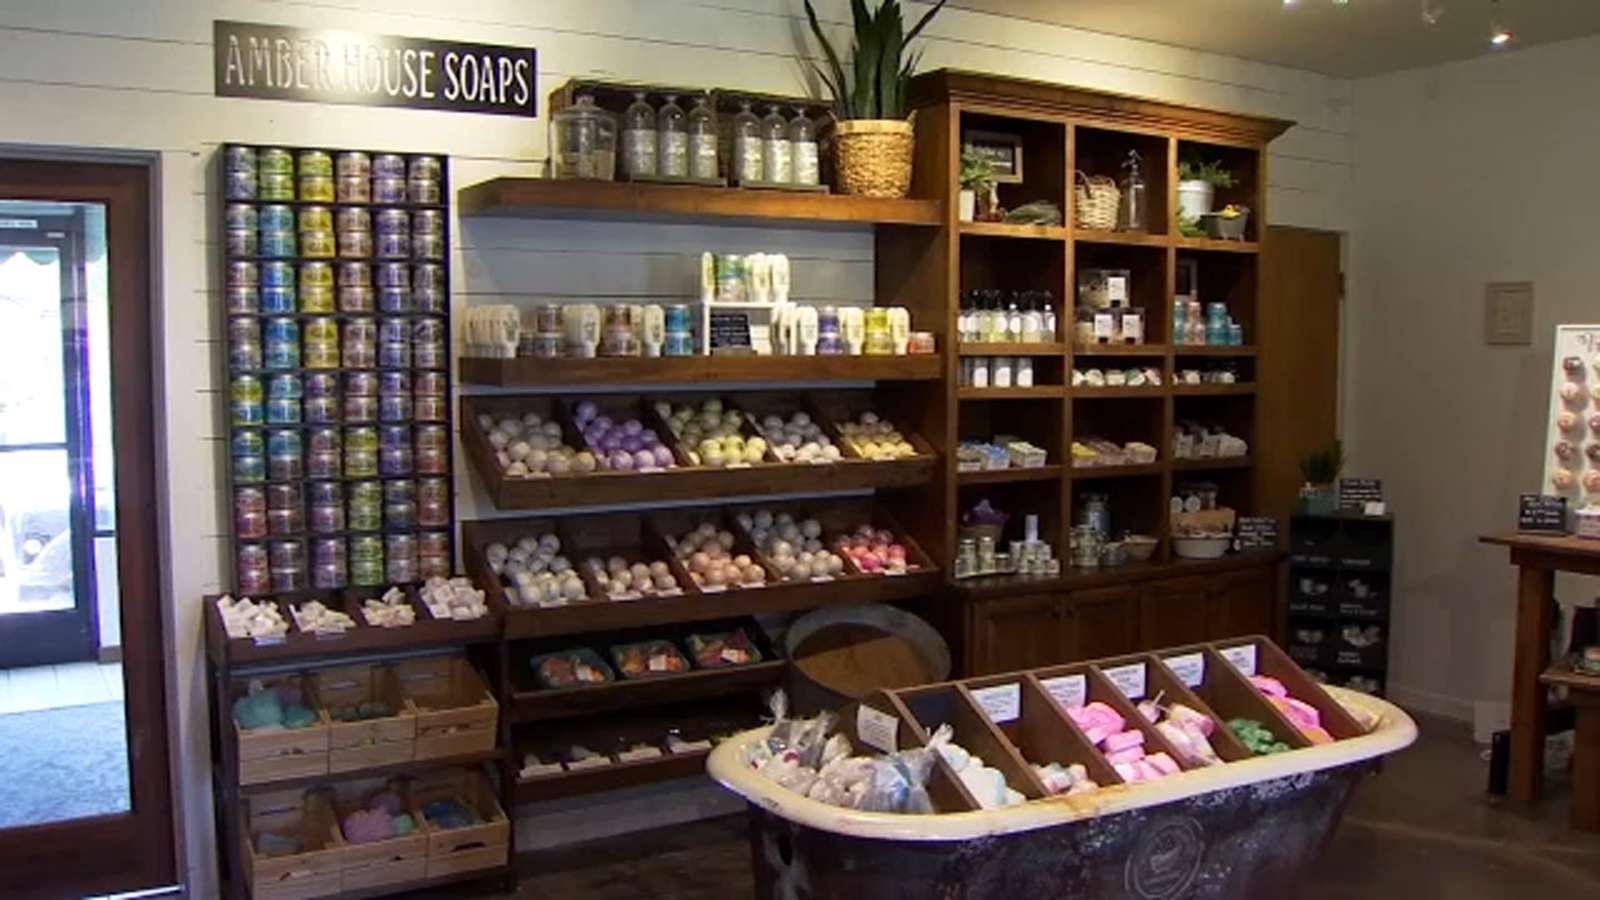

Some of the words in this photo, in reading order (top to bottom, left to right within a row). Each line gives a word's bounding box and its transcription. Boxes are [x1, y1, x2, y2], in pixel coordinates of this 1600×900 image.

[225, 34, 334, 89] AMBER
[343, 41, 435, 98] HOUSE
[443, 52, 529, 105] SOAPS
